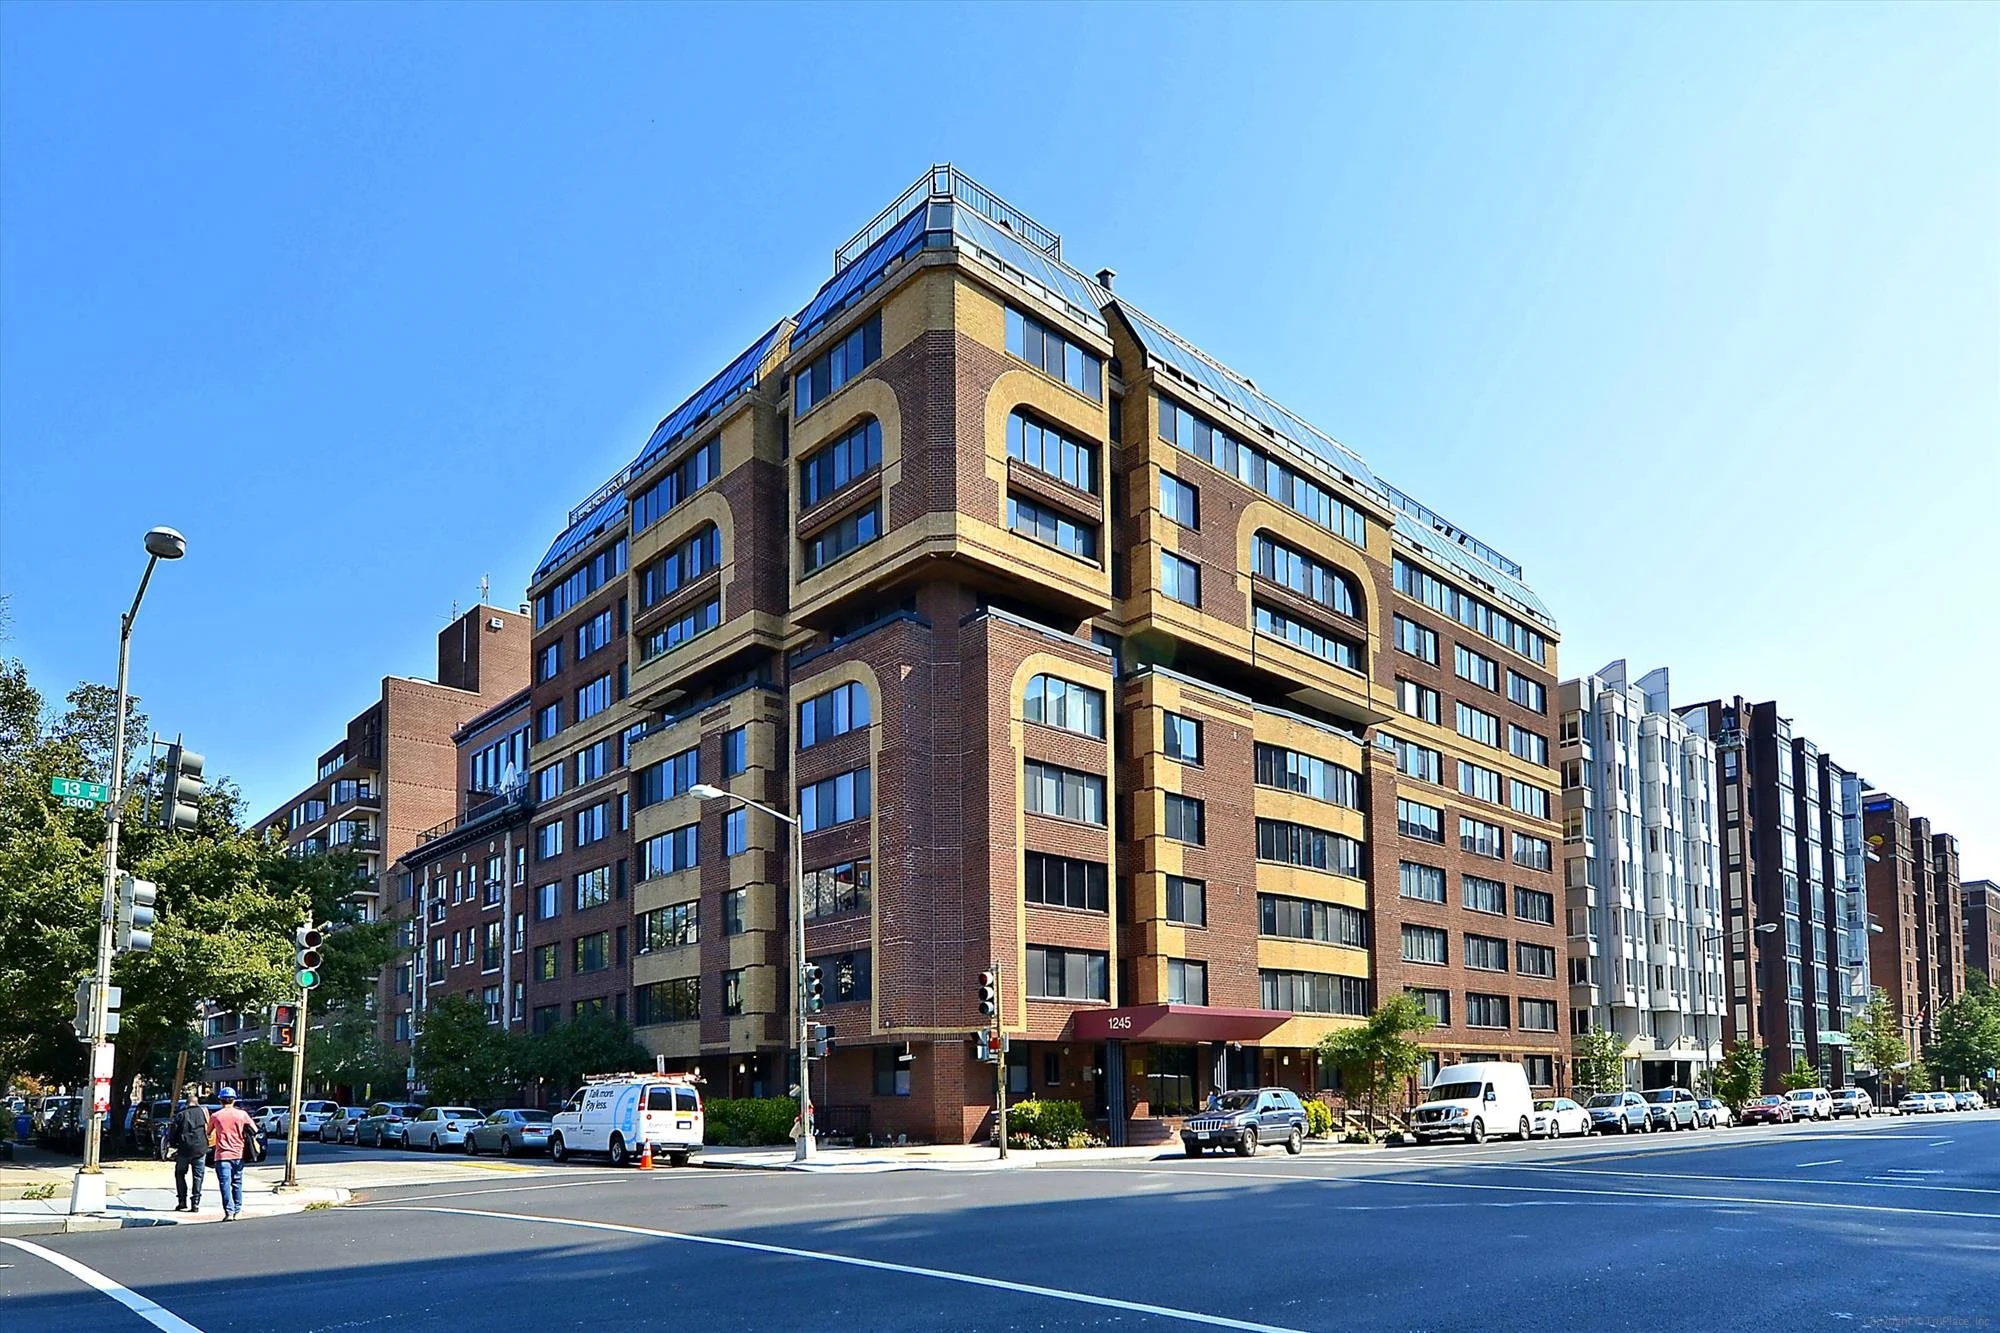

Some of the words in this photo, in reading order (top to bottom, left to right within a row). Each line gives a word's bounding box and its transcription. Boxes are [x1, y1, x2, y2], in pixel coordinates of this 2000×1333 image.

[62, 782, 80, 795] 13
[64, 797, 94, 809] 1300
[1108, 1016, 1131, 1029] 1245
[281, 1028, 290, 1044] 5
[589, 1089, 600, 1098] Talk
[585, 1100, 596, 1111] Pay
